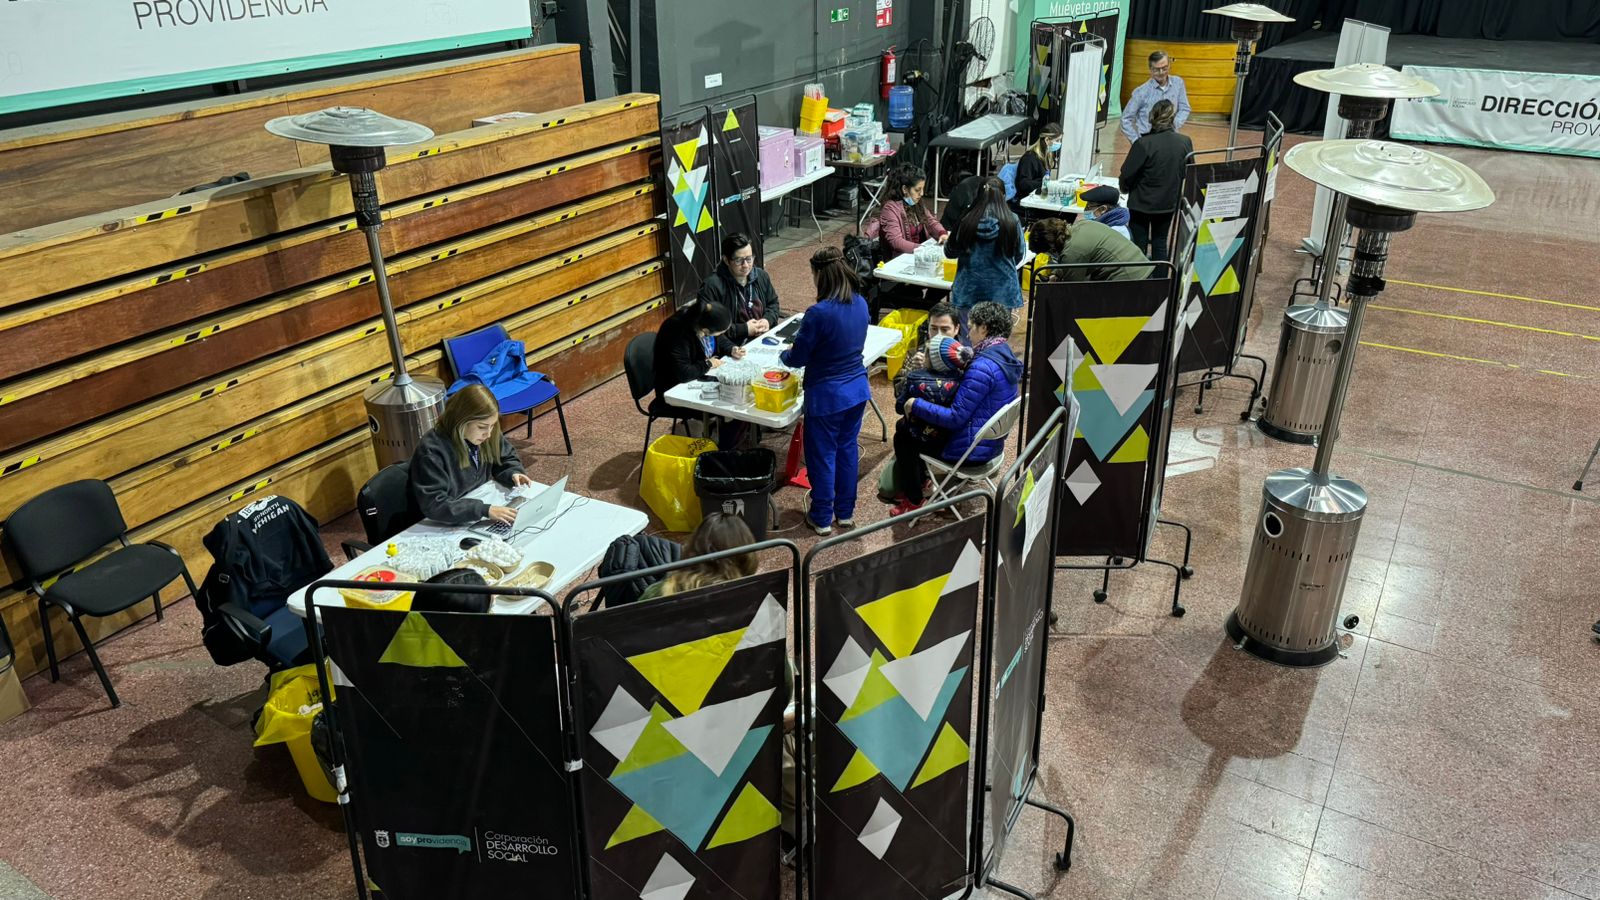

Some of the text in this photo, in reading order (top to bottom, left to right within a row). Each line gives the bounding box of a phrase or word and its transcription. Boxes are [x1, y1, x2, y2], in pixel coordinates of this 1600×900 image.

[1049, 0, 1091, 17] Muévete
[1481, 95, 1600, 121] DIRECCIÓ
[484, 830, 549, 845] Corporación
[486, 840, 558, 855] DESARROLLO
[487, 850, 529, 863] SOCIAL
